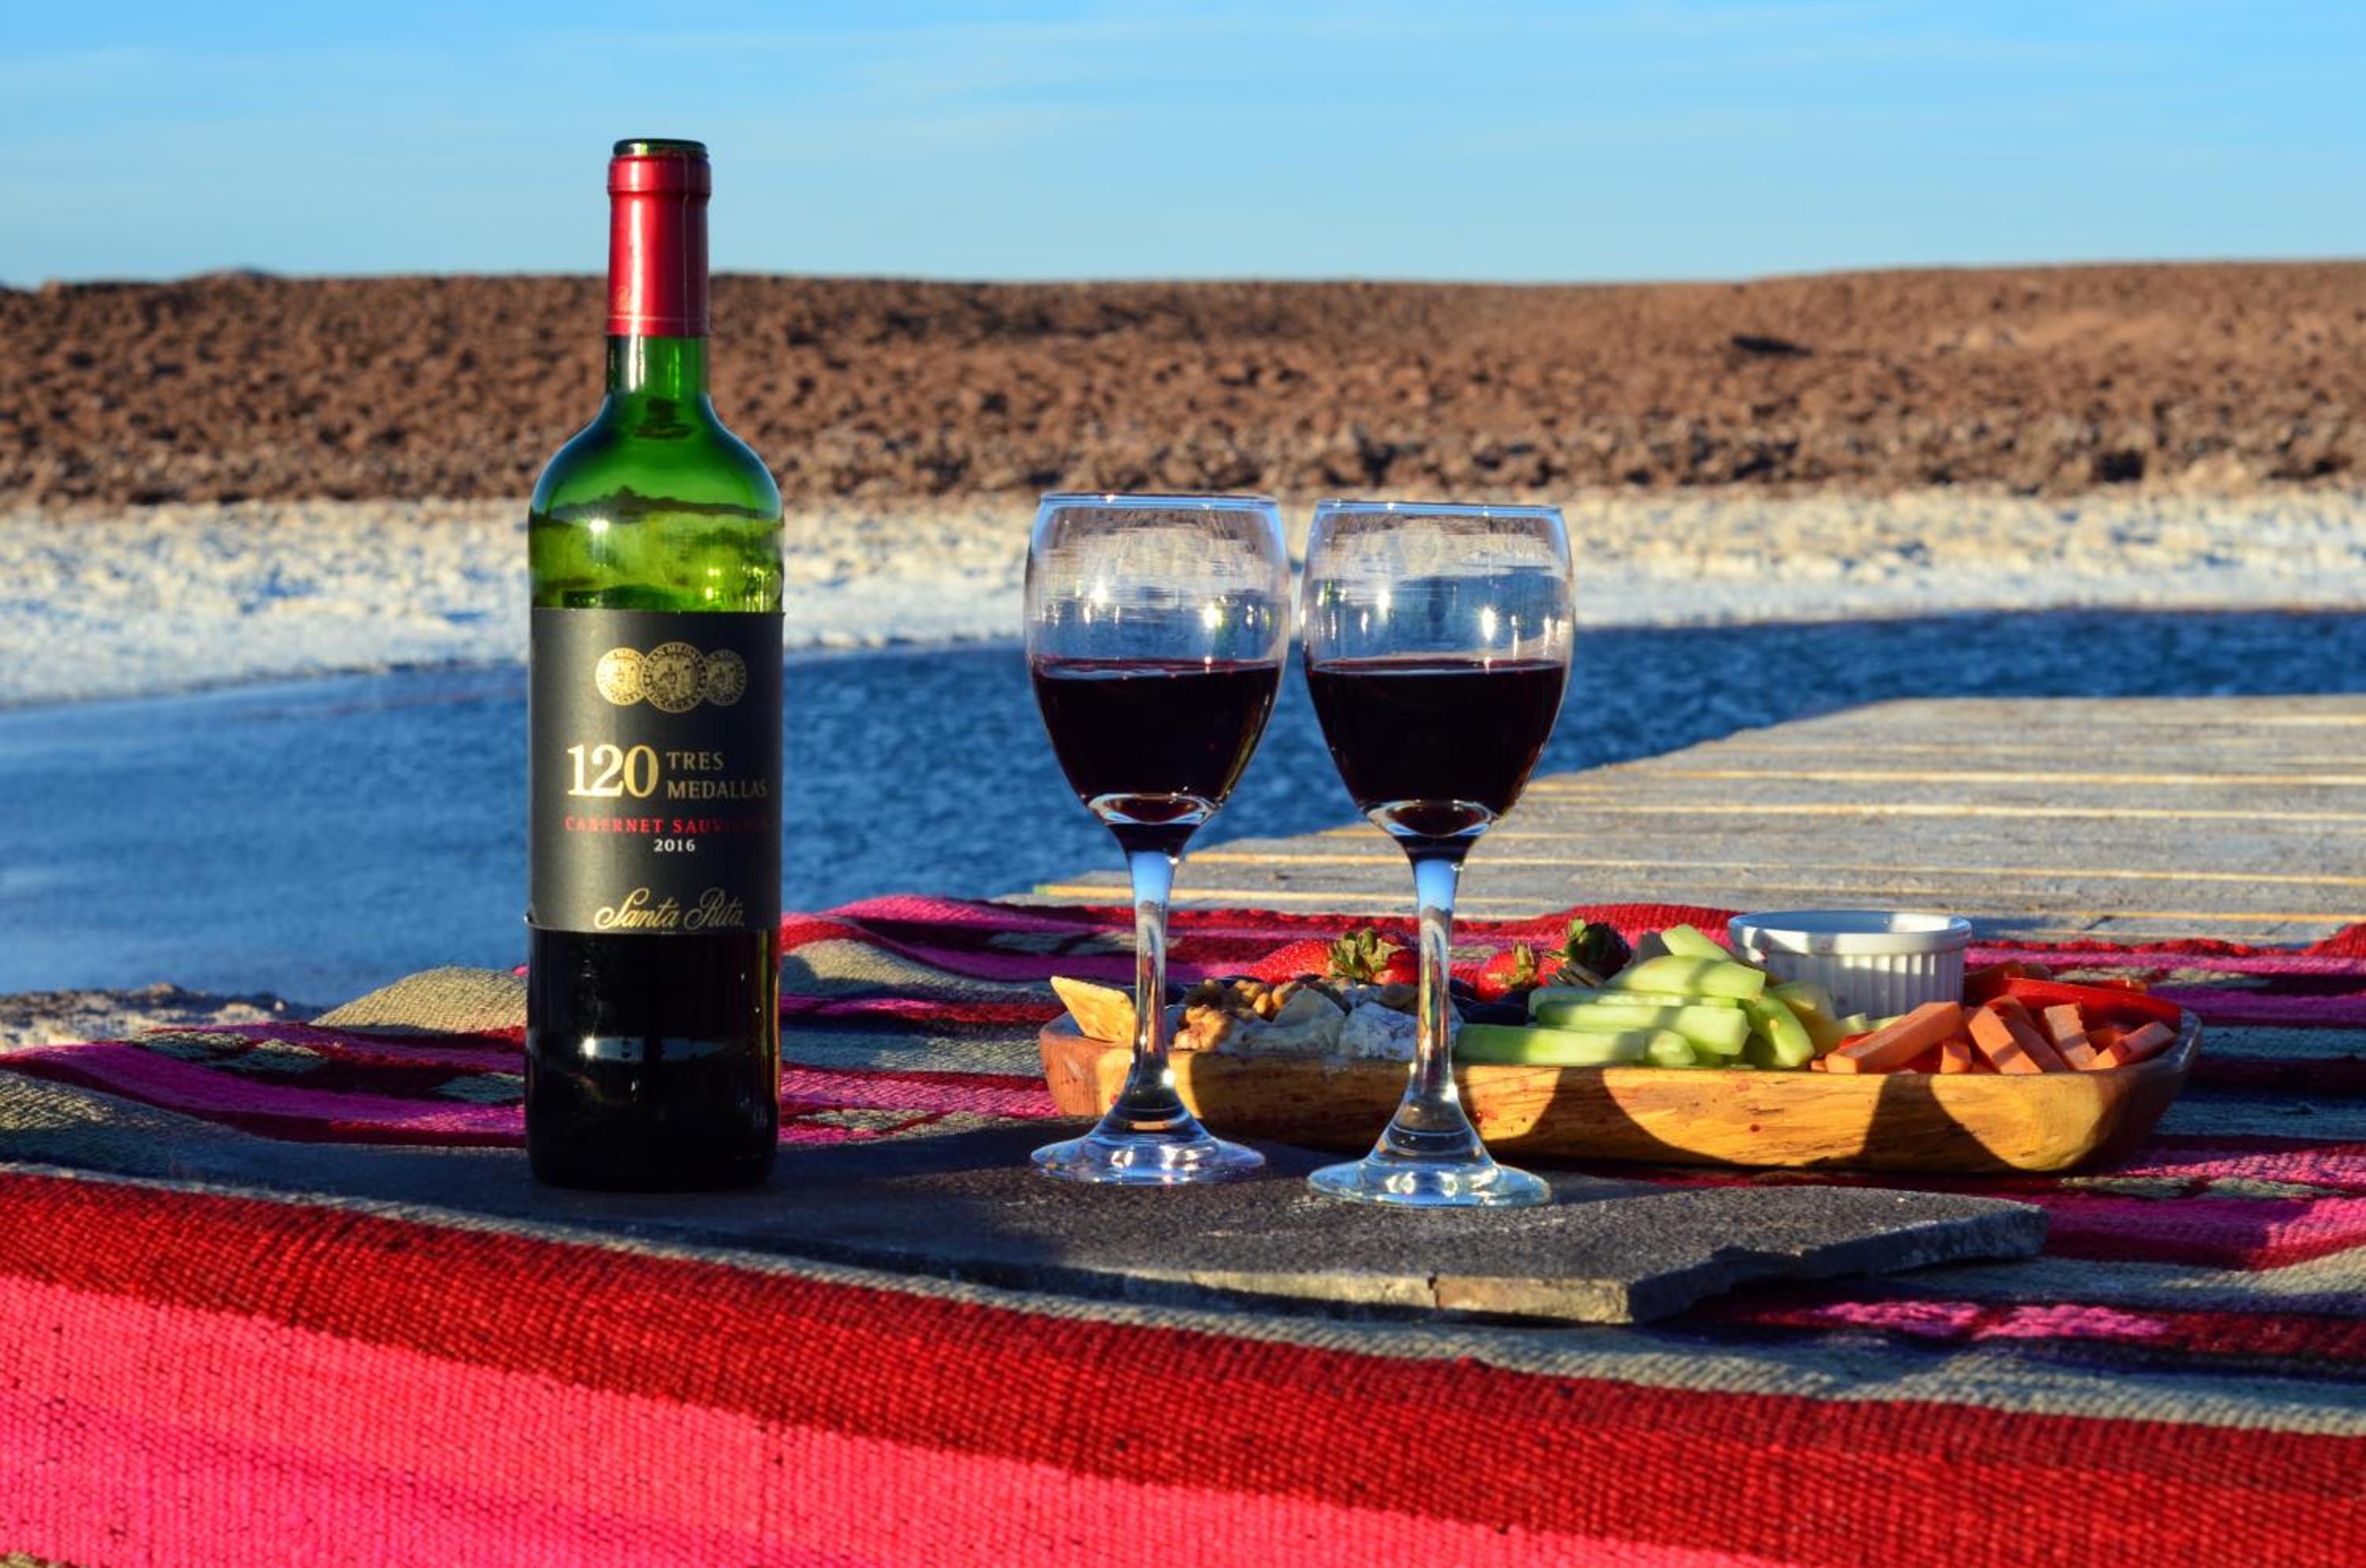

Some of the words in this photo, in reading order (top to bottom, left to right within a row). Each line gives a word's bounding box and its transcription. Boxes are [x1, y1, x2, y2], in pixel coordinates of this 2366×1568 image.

[567, 744, 659, 798] 120
[666, 751, 725, 771] TRES
[667, 778, 768, 799] MEDALLAS
[653, 838, 696, 852] 2016
[594, 887, 679, 930] Santa
